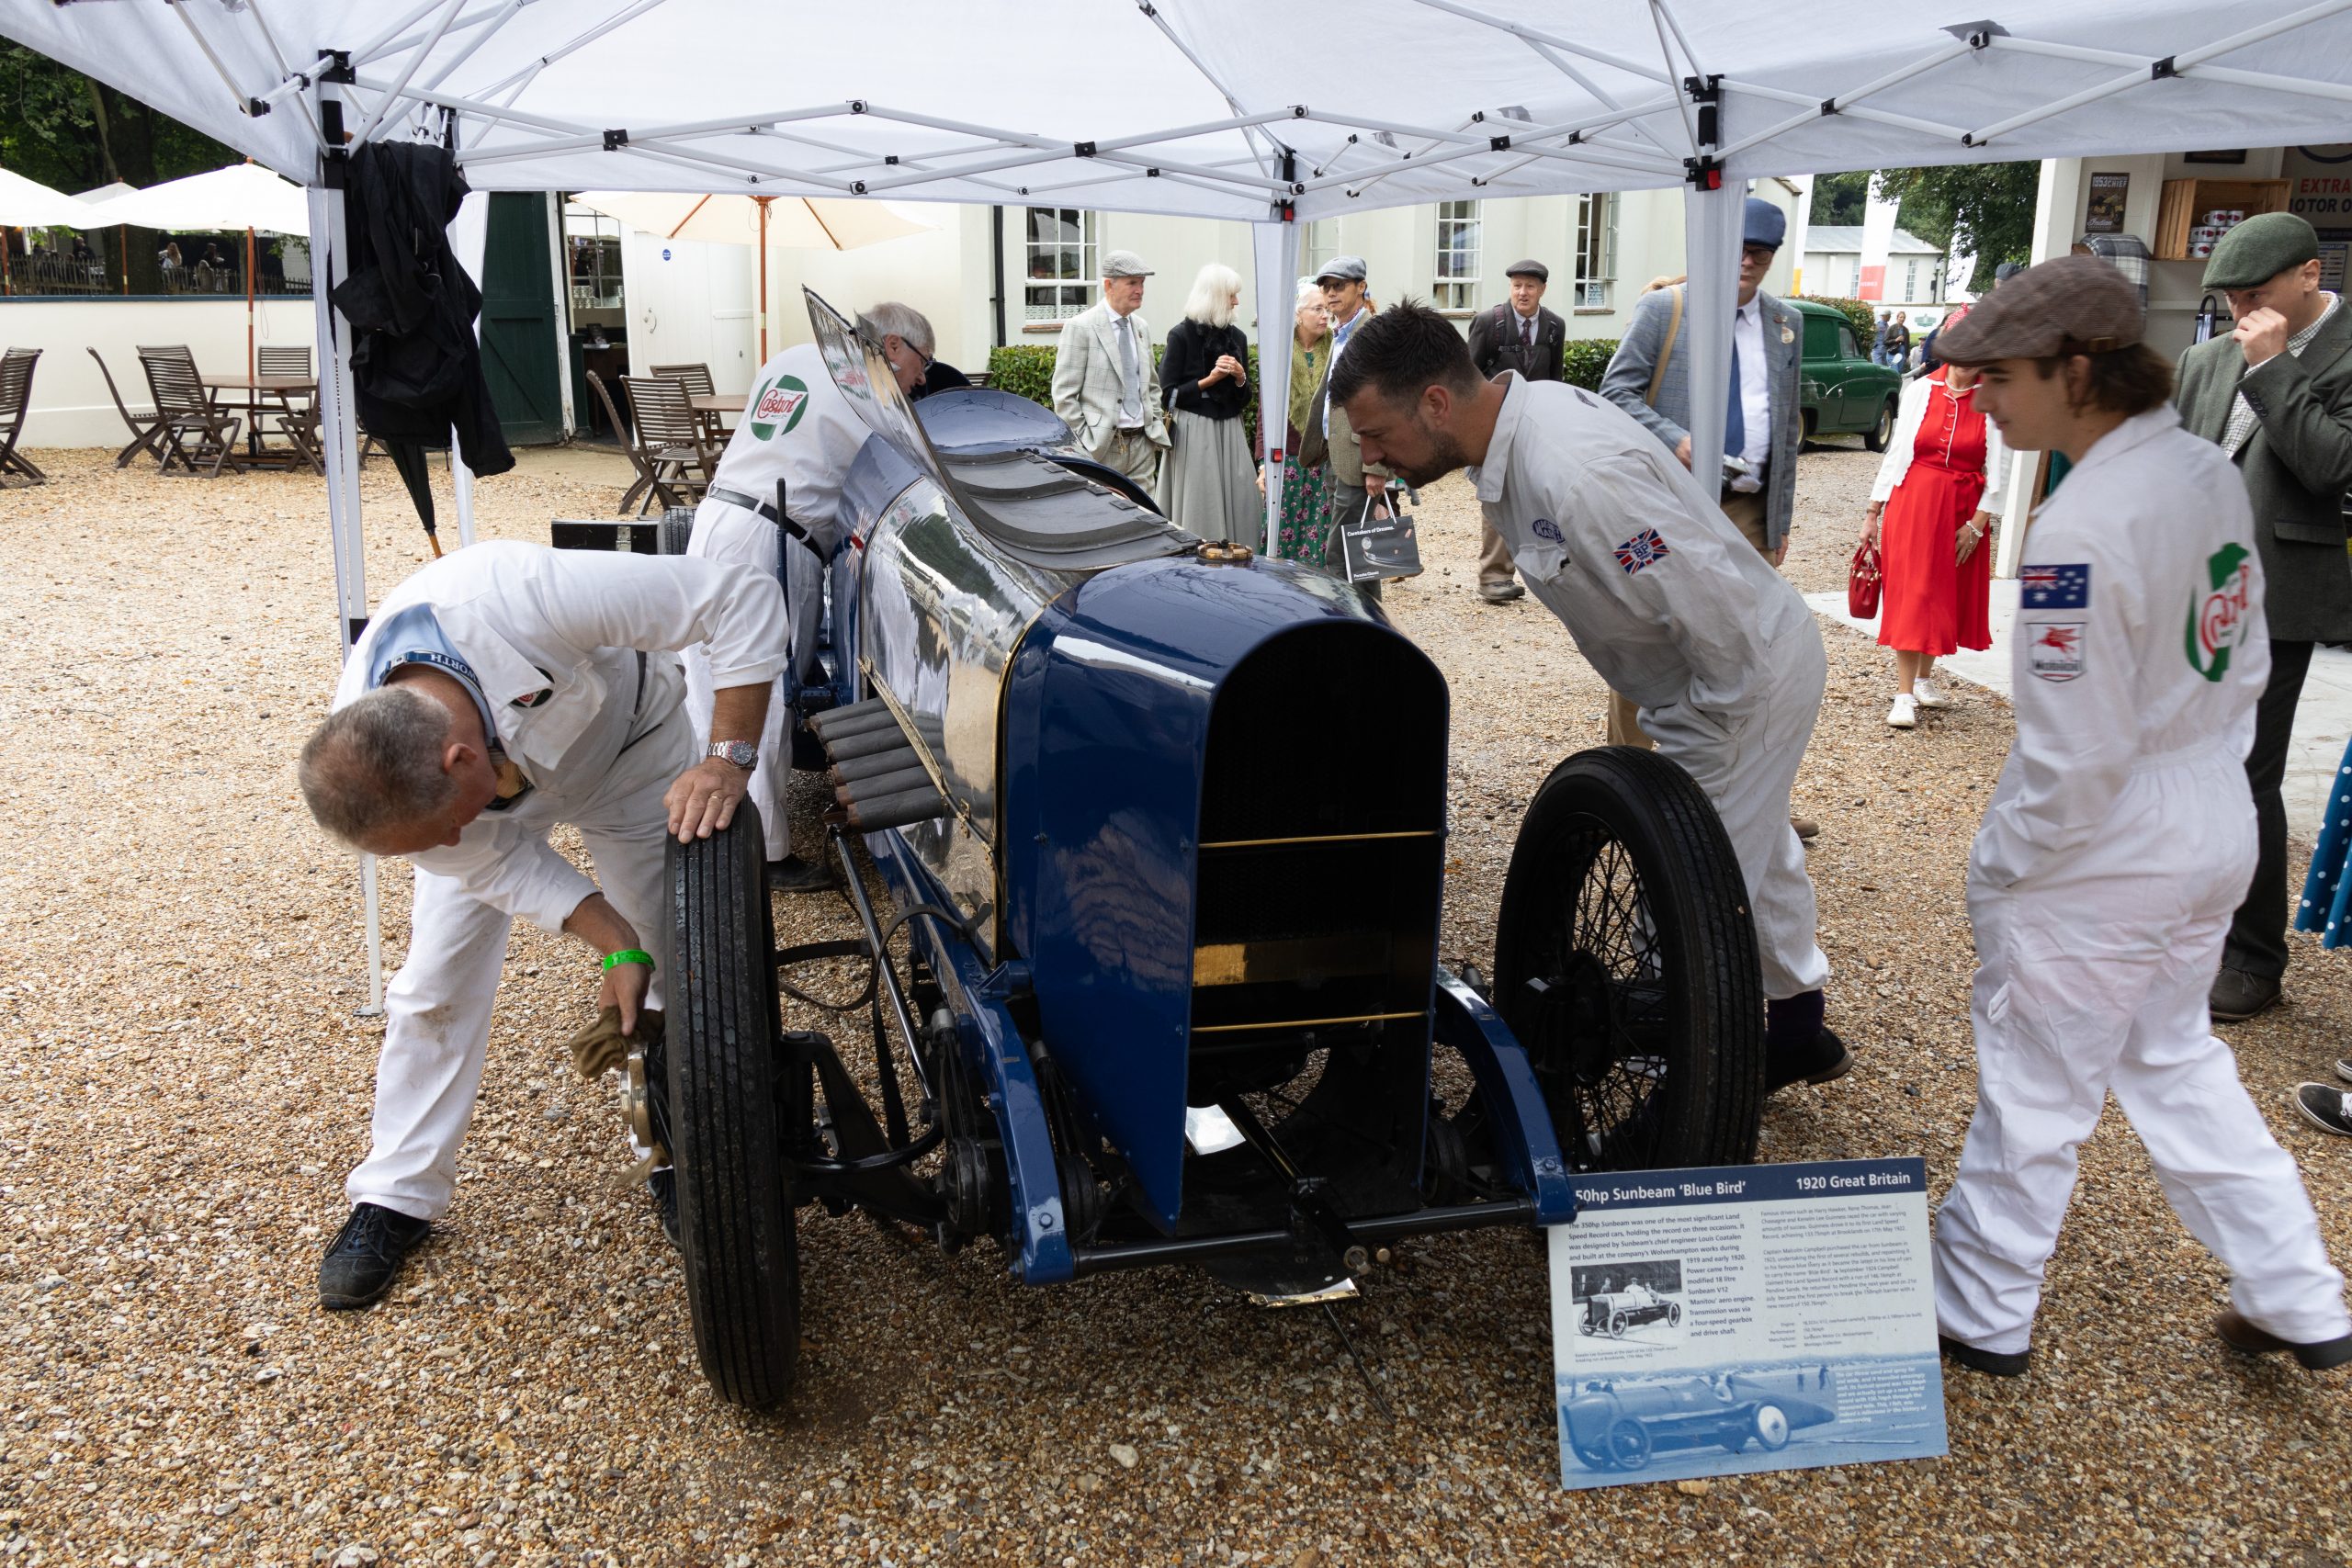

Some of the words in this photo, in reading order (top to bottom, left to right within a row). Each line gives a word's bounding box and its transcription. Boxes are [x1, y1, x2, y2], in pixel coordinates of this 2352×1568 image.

[2300, 178, 2352, 194] EXTRA
[757, 389, 803, 419] Castrol
[1347, 529, 1371, 537] Caretakers
[1634, 544, 1649, 558] BP
[430, 654, 478, 682] WORTH
[1796, 1177, 1826, 1190] 1920
[1829, 1174, 1865, 1187] Great
[1868, 1172, 1910, 1185] Britain
[1575, 1189, 1609, 1204] 50hp
[1612, 1185, 1675, 1200] Sunbeam
[1679, 1182, 1713, 1196] ‘Blue
[1715, 1180, 1746, 1193] Bird’
[1693, 1214, 1724, 1223] significant
[1582, 1242, 1611, 1250] designed
[1671, 1236, 1697, 1245] engineer
[1650, 1247, 1699, 1257] Wolverhampton
[1695, 1318, 1727, 1326] four-speed
[1728, 1316, 1752, 1325] gearbox
